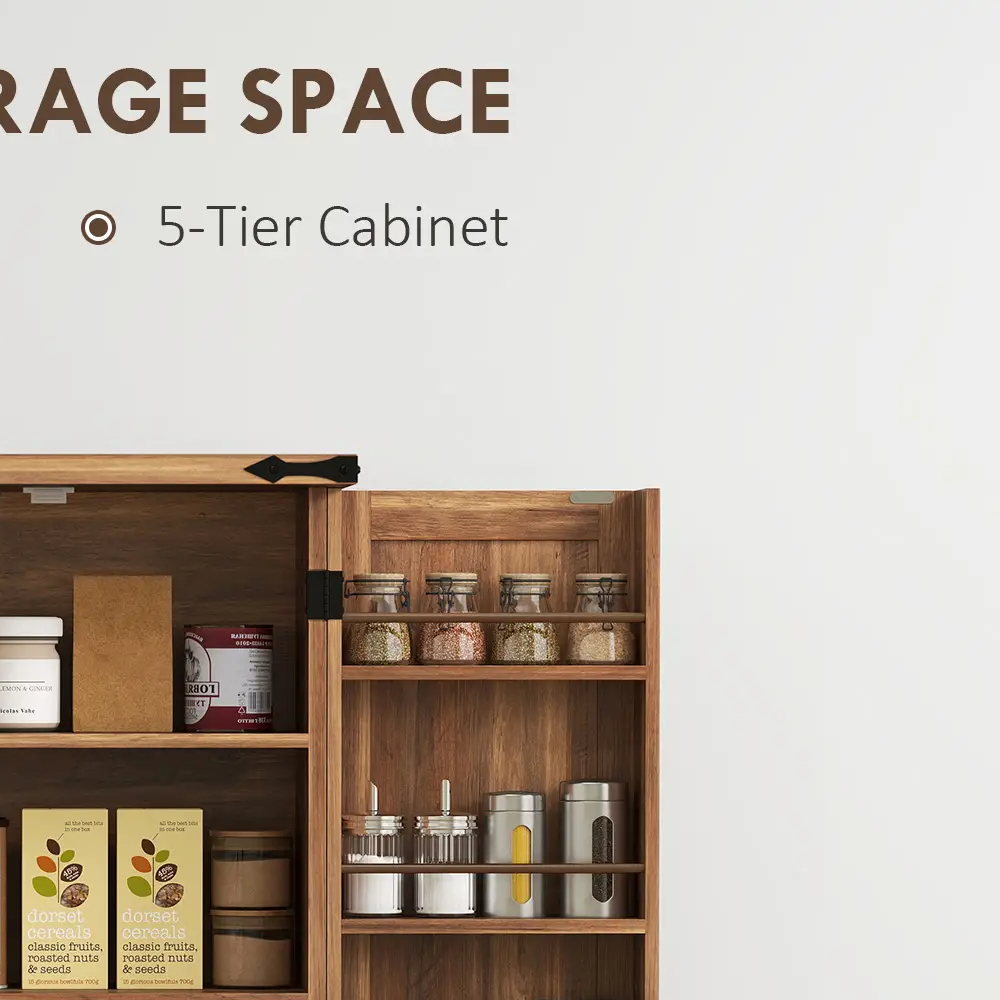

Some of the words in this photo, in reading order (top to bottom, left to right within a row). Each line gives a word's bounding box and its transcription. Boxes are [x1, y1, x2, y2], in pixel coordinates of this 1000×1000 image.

[27, 909, 84, 923] dorset
[122, 909, 179, 923] dorset
[27, 925, 91, 939] cereals
[122, 925, 186, 939] cereals
[27, 942, 66, 951] classic
[69, 942, 103, 952] fruits,
[122, 942, 161, 951] classic
[164, 942, 197, 952] fruits,
[28, 953, 70, 962] roasted
[73, 954, 99, 962] nuts
[122, 953, 165, 962] roasted
[168, 954, 194, 962] nuts
[27, 965, 38, 974] &
[40, 965, 71, 974] seeds
[122, 965, 132, 974] &
[135, 965, 166, 974] seeds
